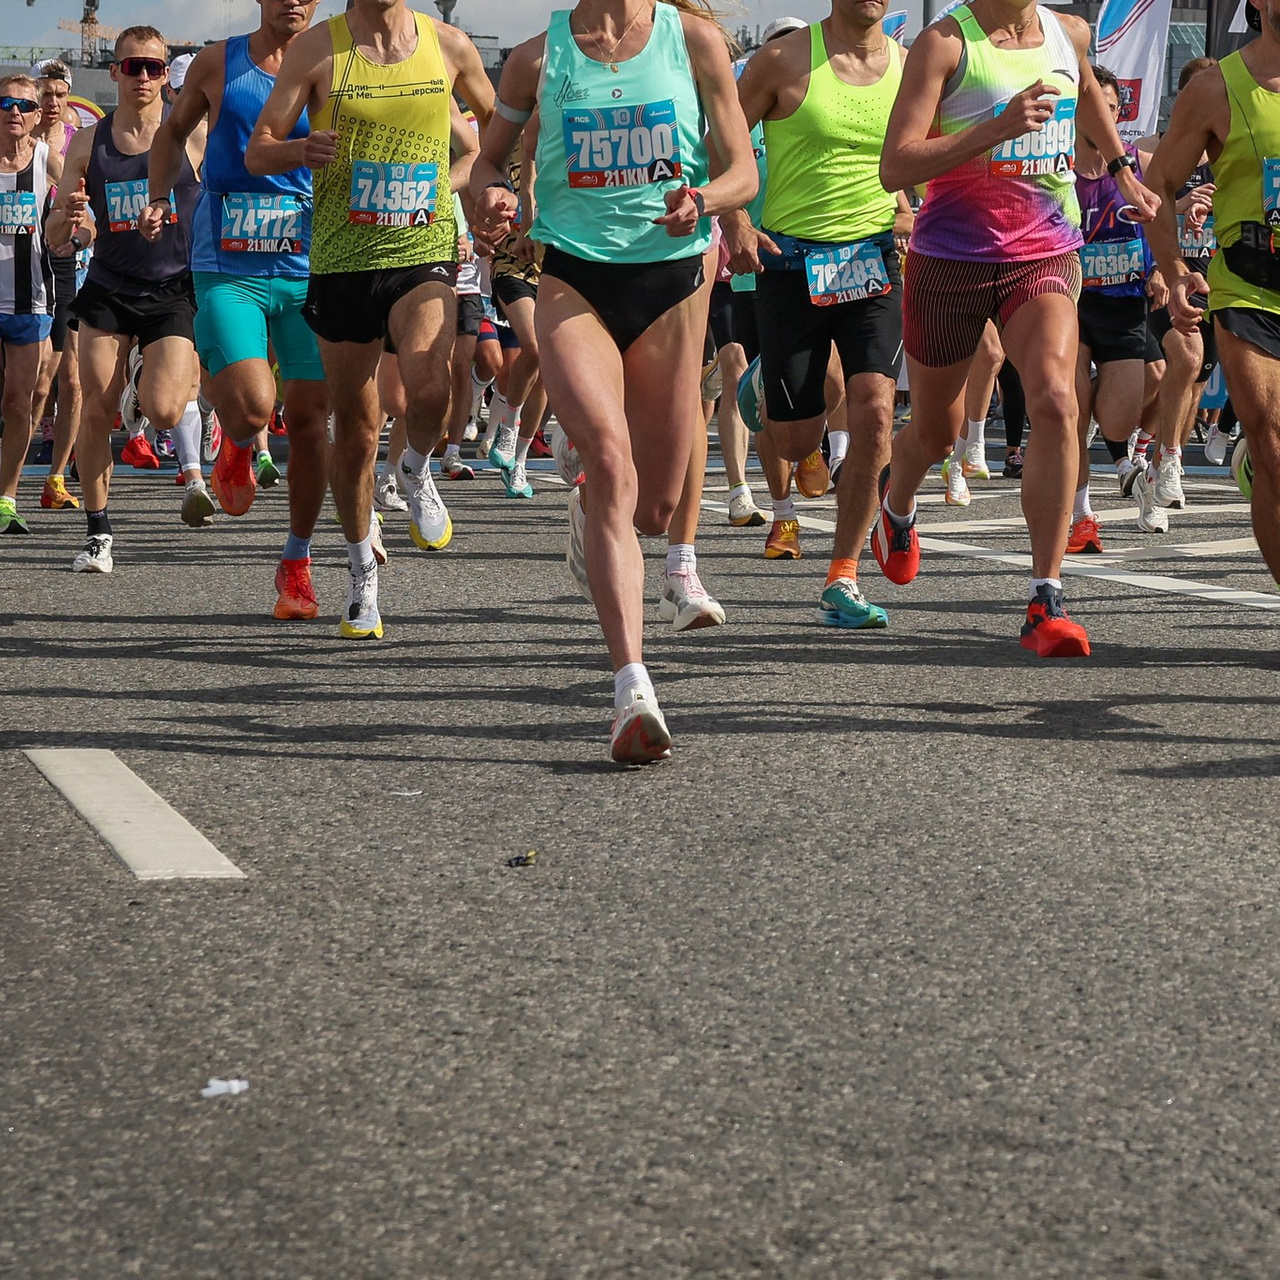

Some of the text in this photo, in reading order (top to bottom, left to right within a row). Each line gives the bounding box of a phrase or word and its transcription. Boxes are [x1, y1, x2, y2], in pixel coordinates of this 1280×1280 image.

[572, 123, 674, 169] 75700
[604, 160, 673, 188] 21.1KM A
[1021, 153, 1069, 176] 21.1KM A
[110, 192, 150, 220] 740
[357, 178, 430, 211] 74352
[0, 204, 33, 225] 632
[229, 208, 297, 238] 74772
[376, 209, 428, 227] 21.1KM A
[1271, 210, 1280, 220] A
[247, 238, 293, 253] 21.1KM A
[1181, 247, 1210, 258] 1.1KM A
[811, 258, 882, 293] 76283
[1084, 251, 1140, 277] 76364
[1101, 271, 1140, 286] 21.1KM A
[835, 279, 882, 304] 21.1KM A
